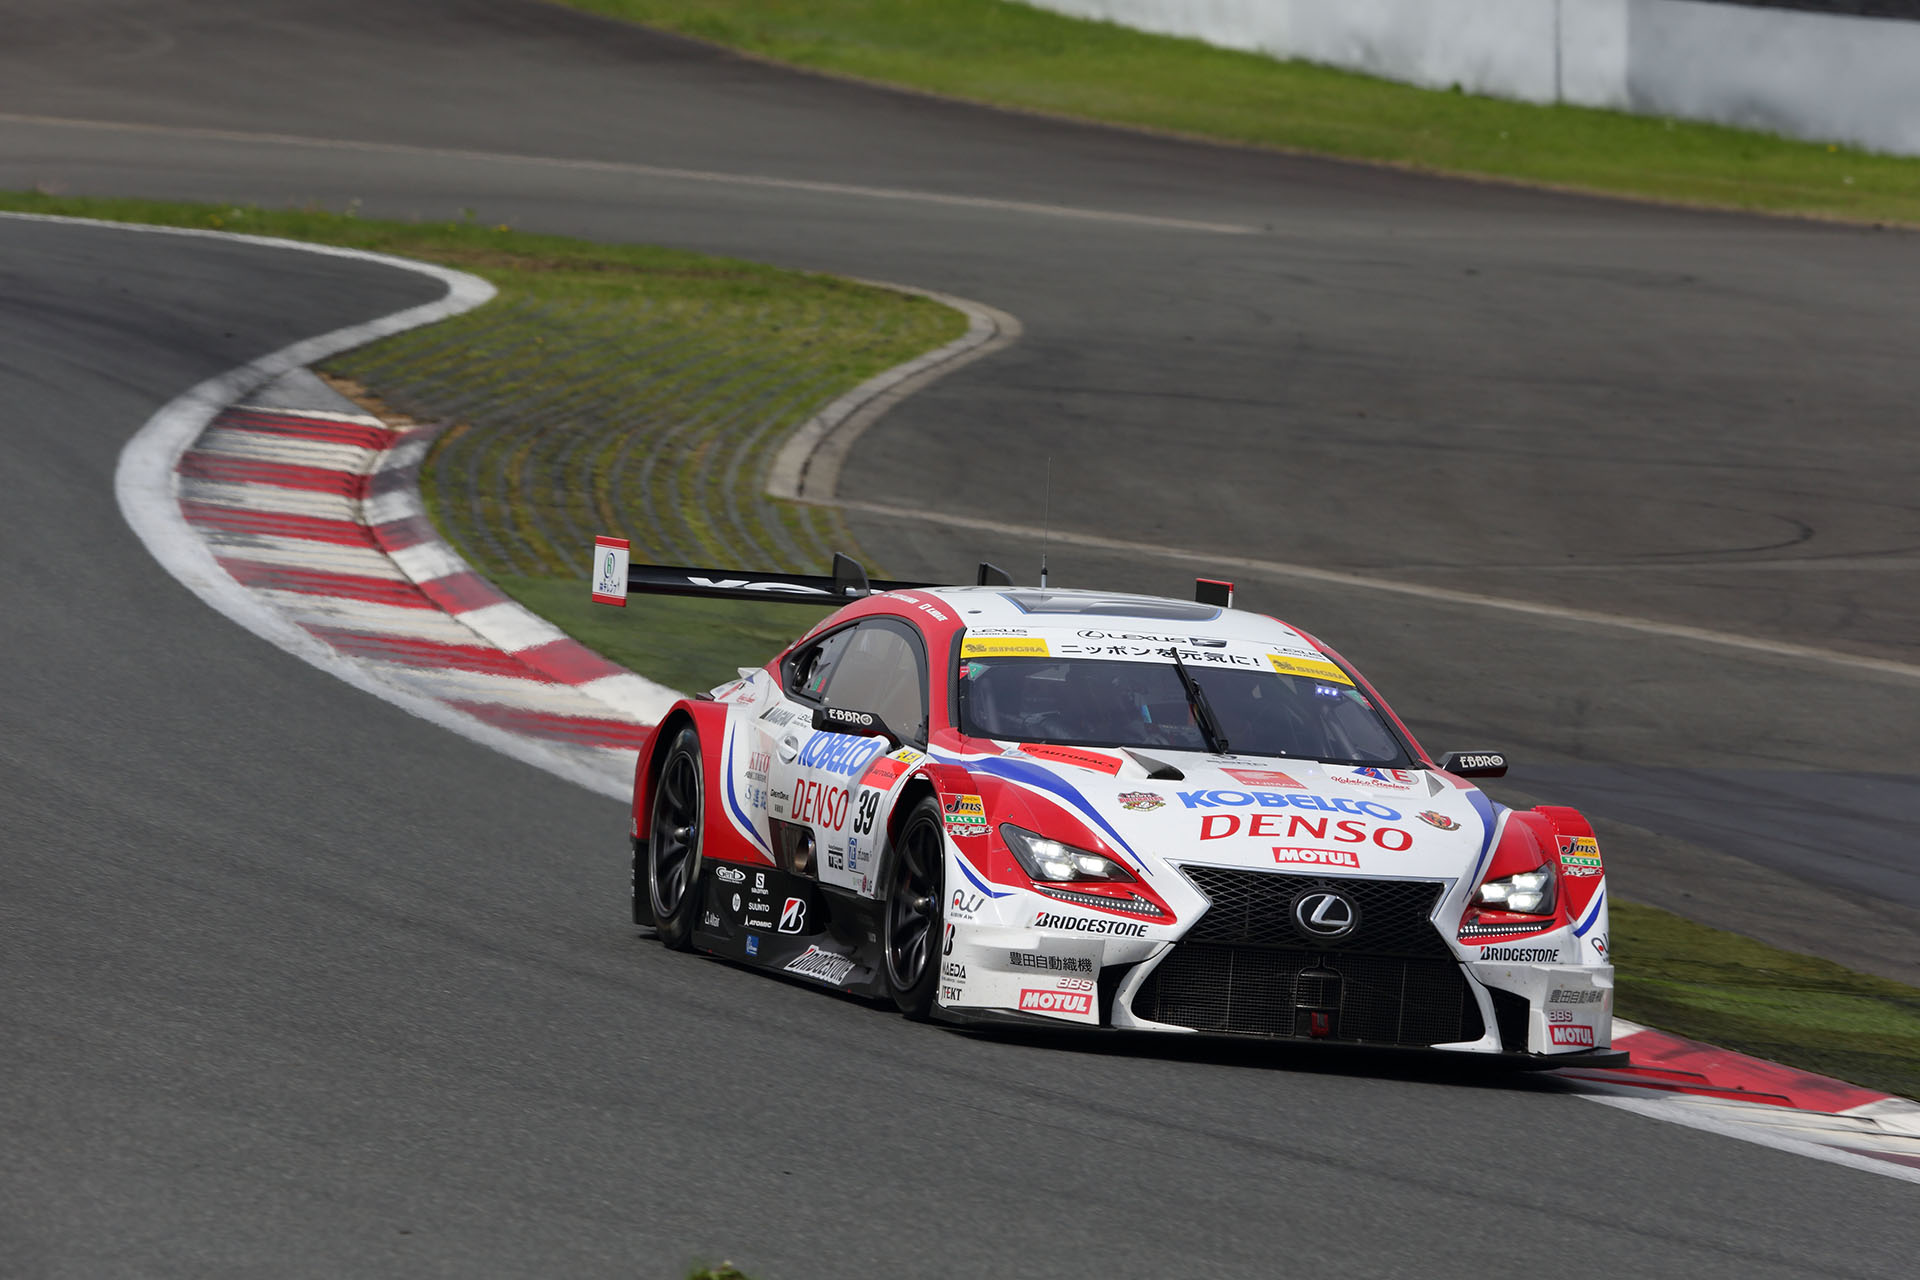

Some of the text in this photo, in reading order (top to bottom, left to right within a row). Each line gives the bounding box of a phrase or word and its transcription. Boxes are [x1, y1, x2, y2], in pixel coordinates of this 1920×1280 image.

[1108, 633, 1187, 643] LEXUS
[828, 708, 873, 726] EBBRO
[797, 730, 881, 777] KOBELCO
[1459, 754, 1504, 769] EBBRO
[791, 778, 850, 832] DENSO
[853, 789, 881, 835] 39
[1176, 789, 1403, 822] KOBELCO
[949, 815, 982, 824] TACTI
[1200, 813, 1413, 851] DENSO
[1278, 848, 1357, 866] MOTUL
[1565, 856, 1598, 866] TACTI
[748, 902, 770, 912] SUUNTO
[1034, 911, 1149, 938] BRIDGESTONE
[1480, 945, 1560, 963] BRIDGESTONE
[783, 944, 856, 985] BRIDGESTONE
[1056, 976, 1093, 991] BBS
[1021, 991, 1088, 1012] MOTUL
[1549, 1010, 1573, 1022] BBS
[1553, 1027, 1593, 1045] MOTUL
